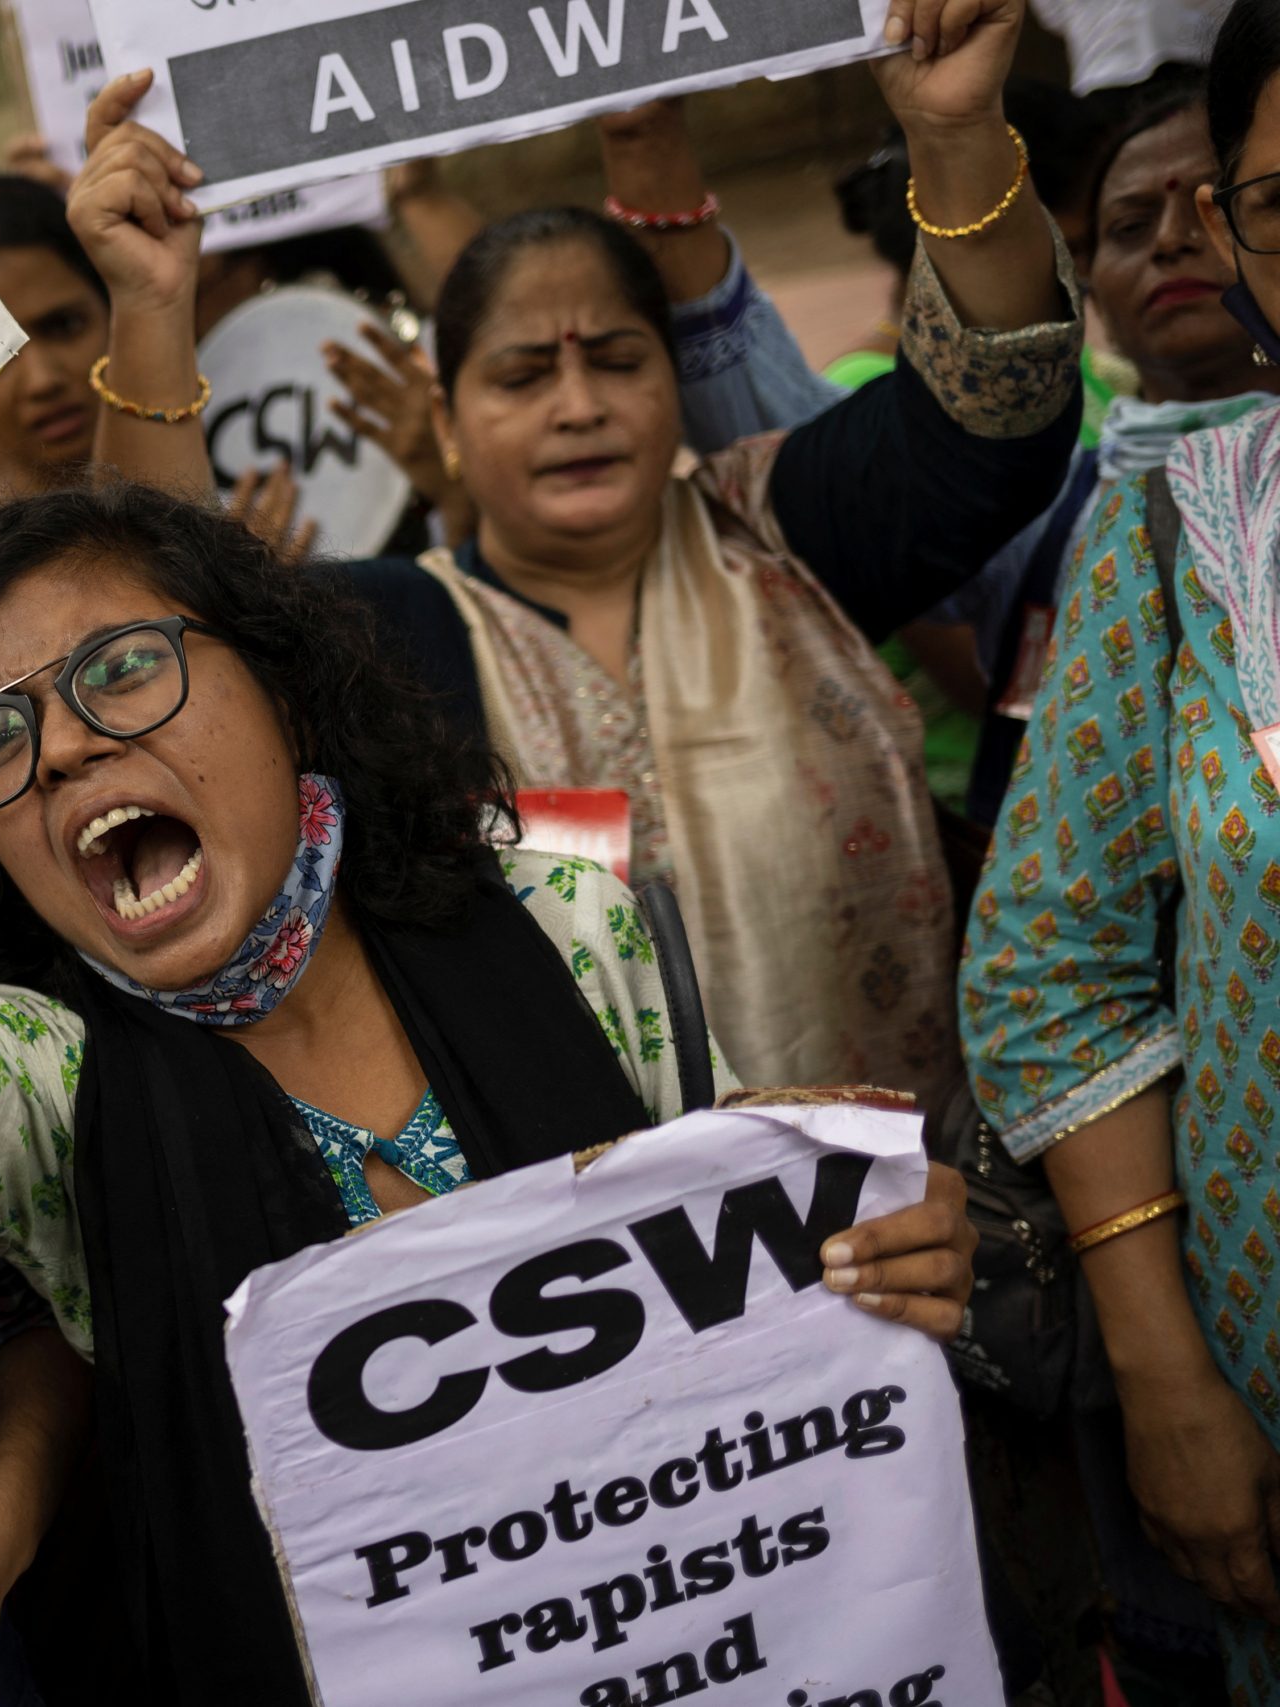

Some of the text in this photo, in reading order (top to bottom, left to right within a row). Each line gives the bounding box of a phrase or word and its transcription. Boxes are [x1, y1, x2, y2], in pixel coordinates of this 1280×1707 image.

[310, 0, 730, 133] AIDWA
[206, 384, 361, 490] CSW
[306, 1152, 876, 1452] CSW
[355, 1384, 907, 1609] Protecting
[469, 1505, 832, 1674] rapists
[579, 1612, 769, 1707] and
